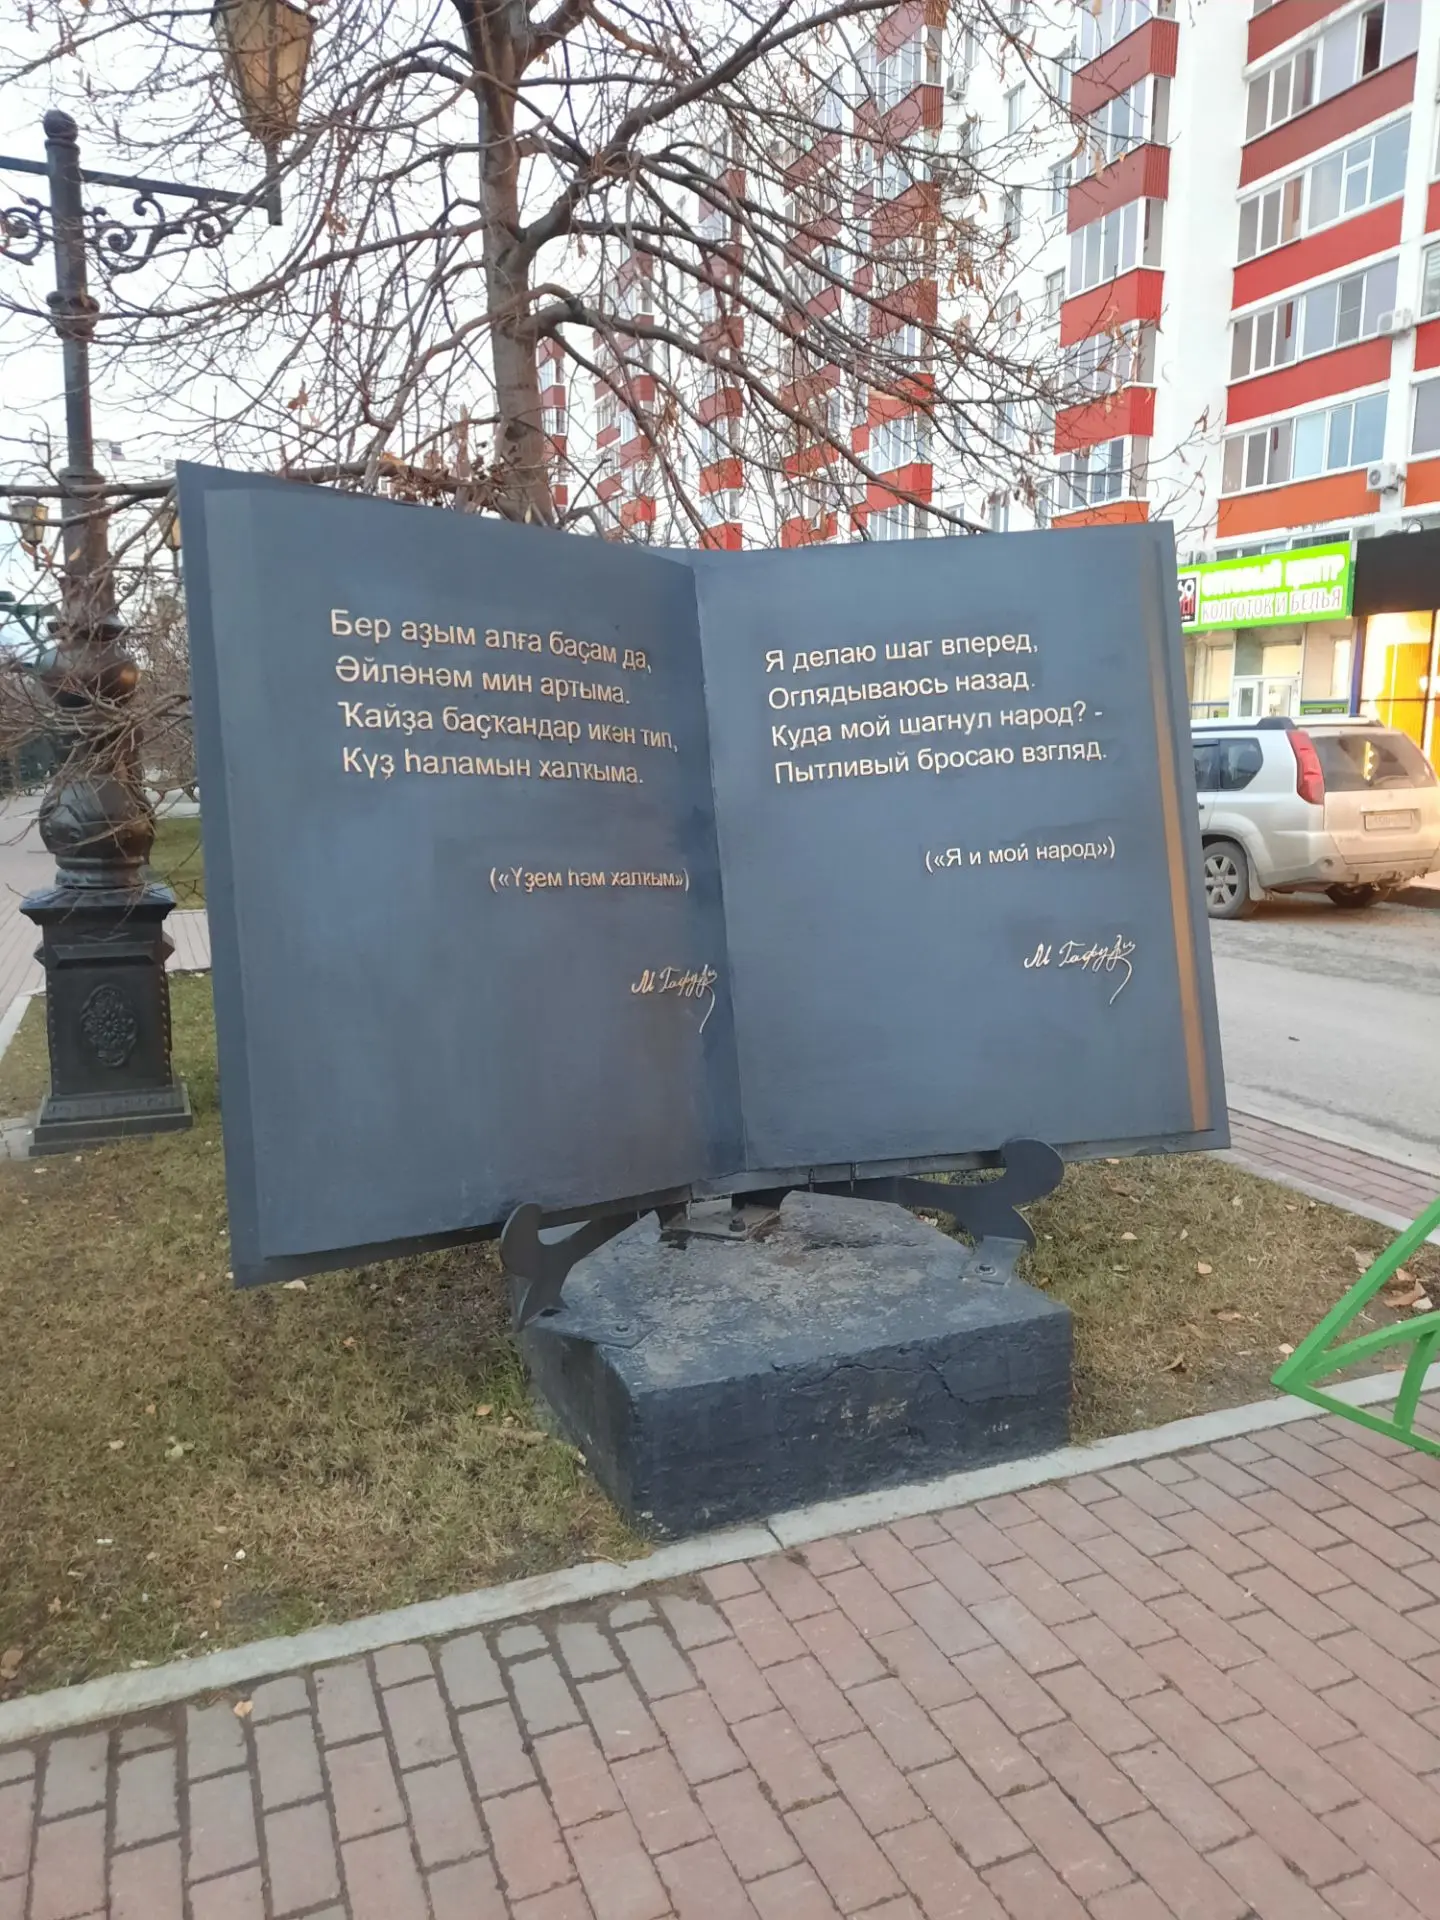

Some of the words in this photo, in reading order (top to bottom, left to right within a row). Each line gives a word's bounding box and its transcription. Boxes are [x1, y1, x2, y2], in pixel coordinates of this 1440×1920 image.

[1202, 595, 1274, 623] КОЛГОТОК
[1276, 594, 1286, 617] И
[1290, 588, 1342, 613] БЕЛЬЯ
[331, 609, 391, 643] Бер
[485, 629, 541, 652] алға
[622, 649, 651, 673] да,
[766, 650, 784, 672] Я
[793, 645, 876, 673] делаю
[886, 640, 932, 660] шаг
[942, 634, 1038, 657] вперед,
[336, 655, 472, 688] Әйләнәм
[482, 672, 532, 692] мин
[541, 677, 630, 704] артыма.
[769, 678, 948, 709] Оглядываюсь
[956, 672, 1035, 692] назад.
[588, 723, 635, 744] икән
[640, 729, 677, 752] тип,
[772, 725, 832, 751] Куда
[841, 715, 890, 739] мой
[900, 712, 992, 735] шагнул
[1000, 701, 1086, 730] народ?
[405, 748, 530, 776] һаламын
[775, 751, 909, 784] Пытливый
[917, 748, 1014, 774] бросаю
[1022, 742, 1106, 762] взгляд.
[926, 848, 961, 873] («Я
[970, 851, 981, 865] и
[989, 843, 1028, 863] мой
[1037, 836, 1115, 862] народ»)
[568, 869, 605, 886] һәм
